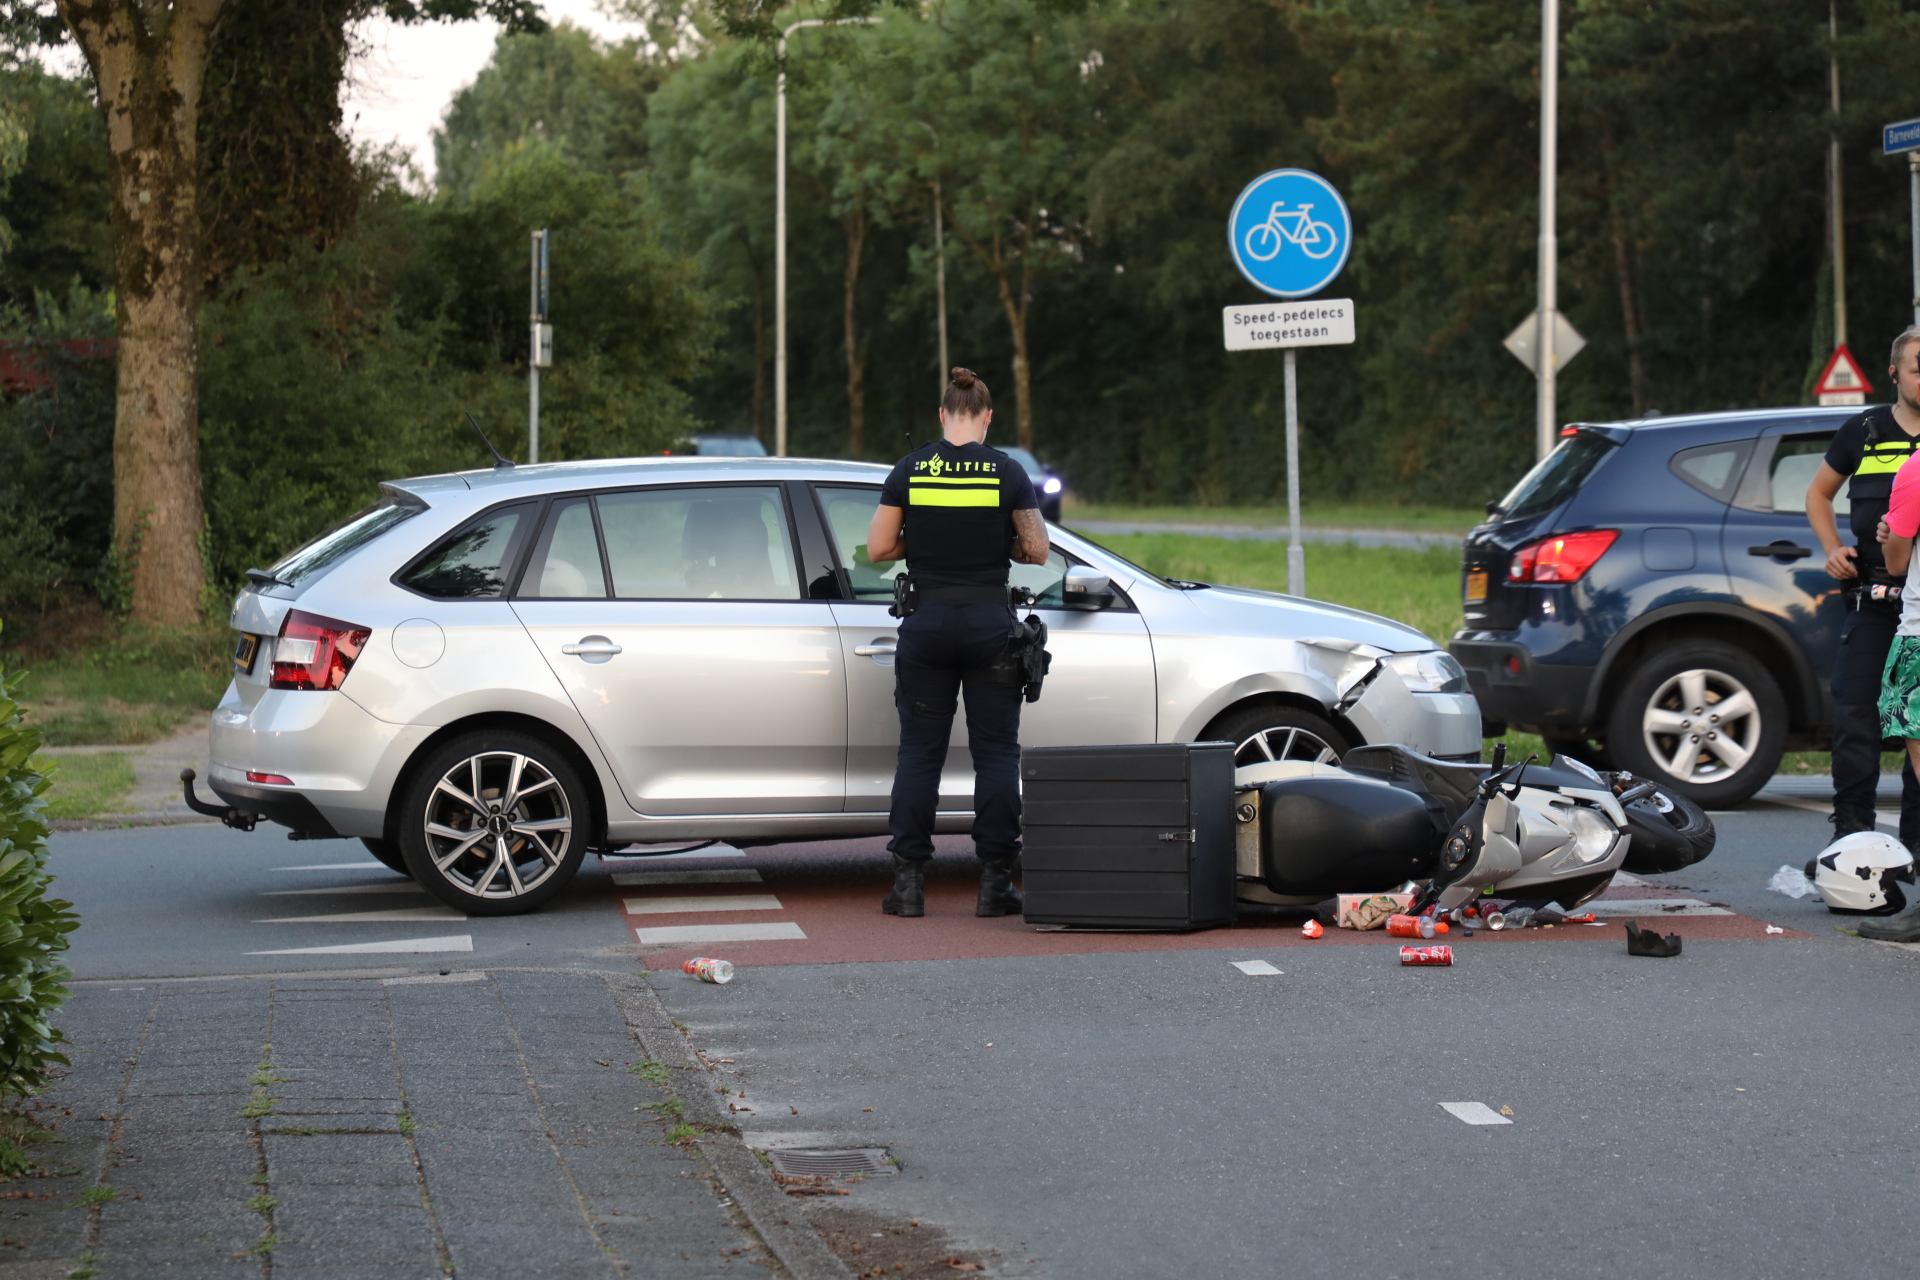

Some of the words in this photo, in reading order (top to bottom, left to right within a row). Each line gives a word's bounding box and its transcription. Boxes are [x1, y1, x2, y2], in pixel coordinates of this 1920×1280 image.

[1234, 308, 1344, 326] Speed-pedelecs
[1250, 326, 1329, 342] toegestaan
[919, 458, 991, 476] POLITIE
